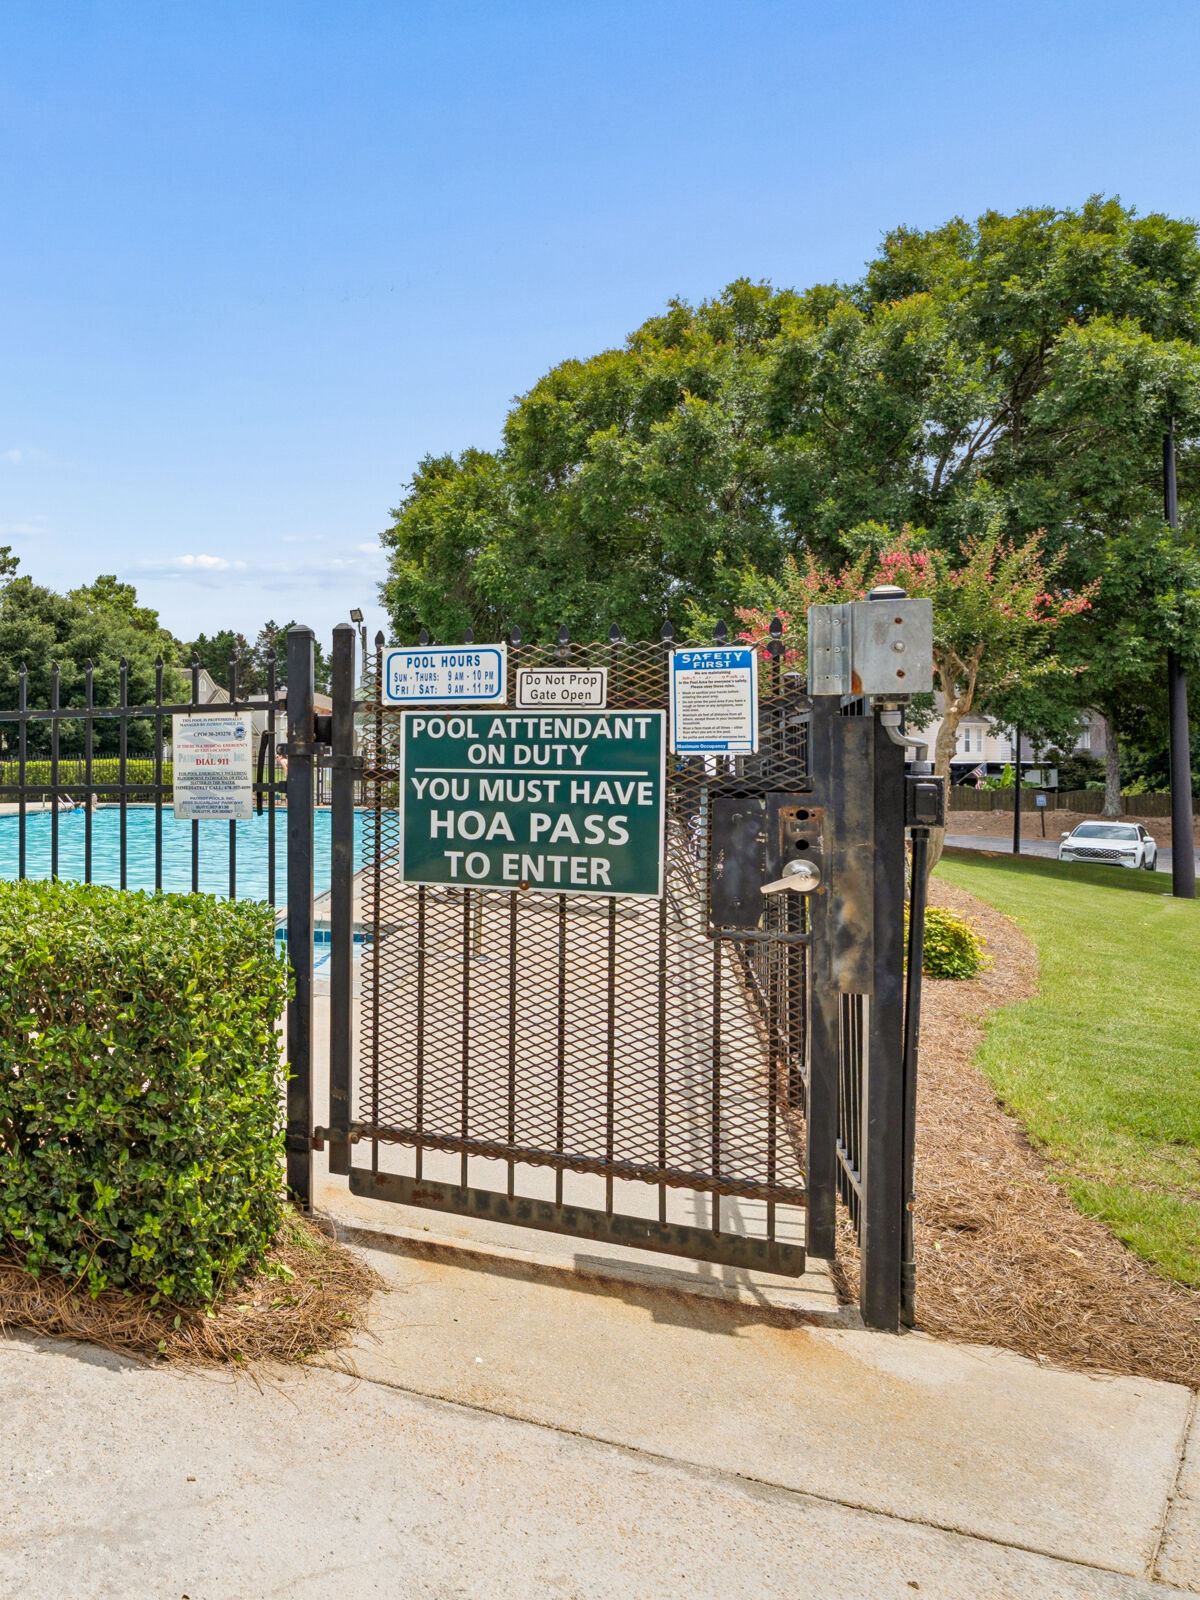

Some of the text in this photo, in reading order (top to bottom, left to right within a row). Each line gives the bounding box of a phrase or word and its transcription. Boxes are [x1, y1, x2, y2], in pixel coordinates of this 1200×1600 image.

[407, 655, 481, 668] POOL HOURS
[682, 652, 742, 663] SAFETY
[394, 672, 407, 682] SUN
[416, 672, 440, 682] THURS:
[448, 671, 452, 680] 9
[454, 672, 464, 680] AM
[473, 670, 481, 680] 10
[484, 671, 494, 680] PM
[526, 675, 597, 687] Do Not Prop
[395, 685, 408, 695] FRI
[419, 684, 438, 694] SAT:
[448, 684, 452, 694] 9
[454, 685, 464, 693] AM
[473, 683, 481, 693] 11
[484, 684, 494, 693] PM
[530, 689, 591, 702] Gate Open
[412, 718, 652, 739] POOL ATTENDANT
[467, 743, 588, 766] ON DUTY
[411, 778, 653, 806] YOU MUST HAVE
[430, 809, 630, 846] HOA PASS
[444, 850, 612, 886] TO ENTER
